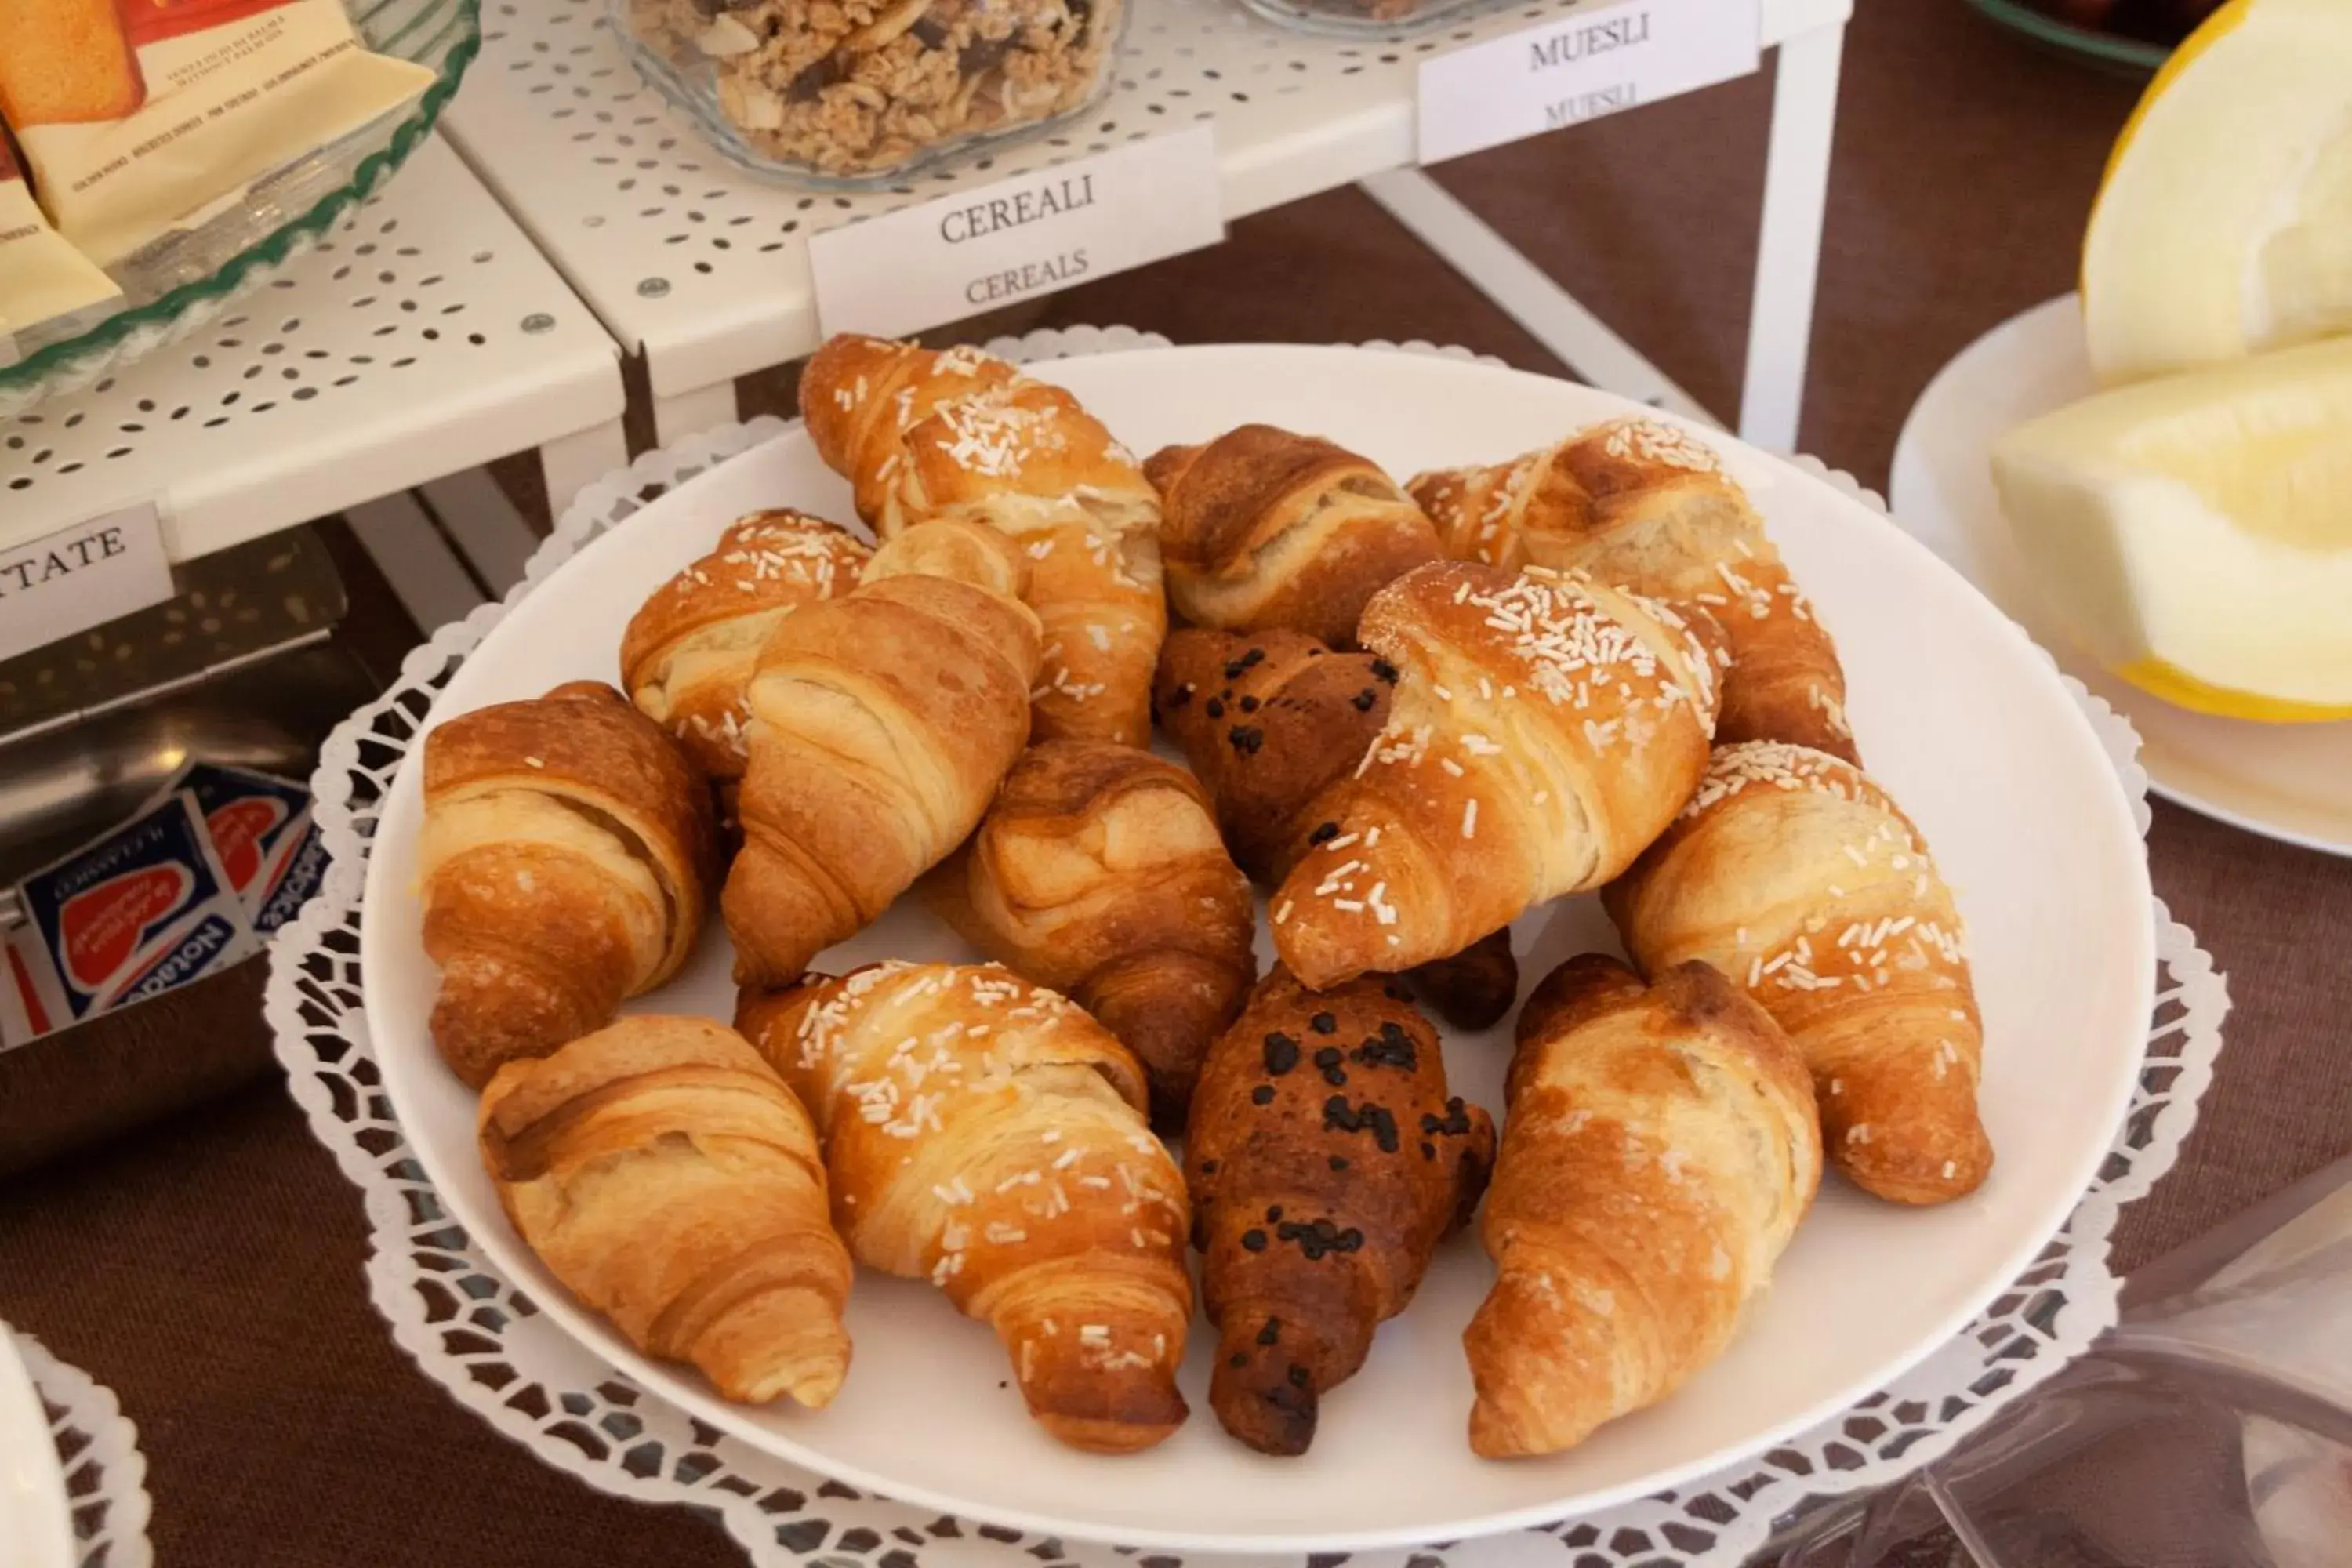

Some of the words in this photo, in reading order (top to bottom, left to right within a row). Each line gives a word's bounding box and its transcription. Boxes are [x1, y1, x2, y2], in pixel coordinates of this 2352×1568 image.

[1530, 13, 1650, 71] MUESLI
[1544, 82, 1638, 129] MUESLI
[940, 175, 1096, 244] CEREALI
[966, 250, 1090, 305] CEREALS
